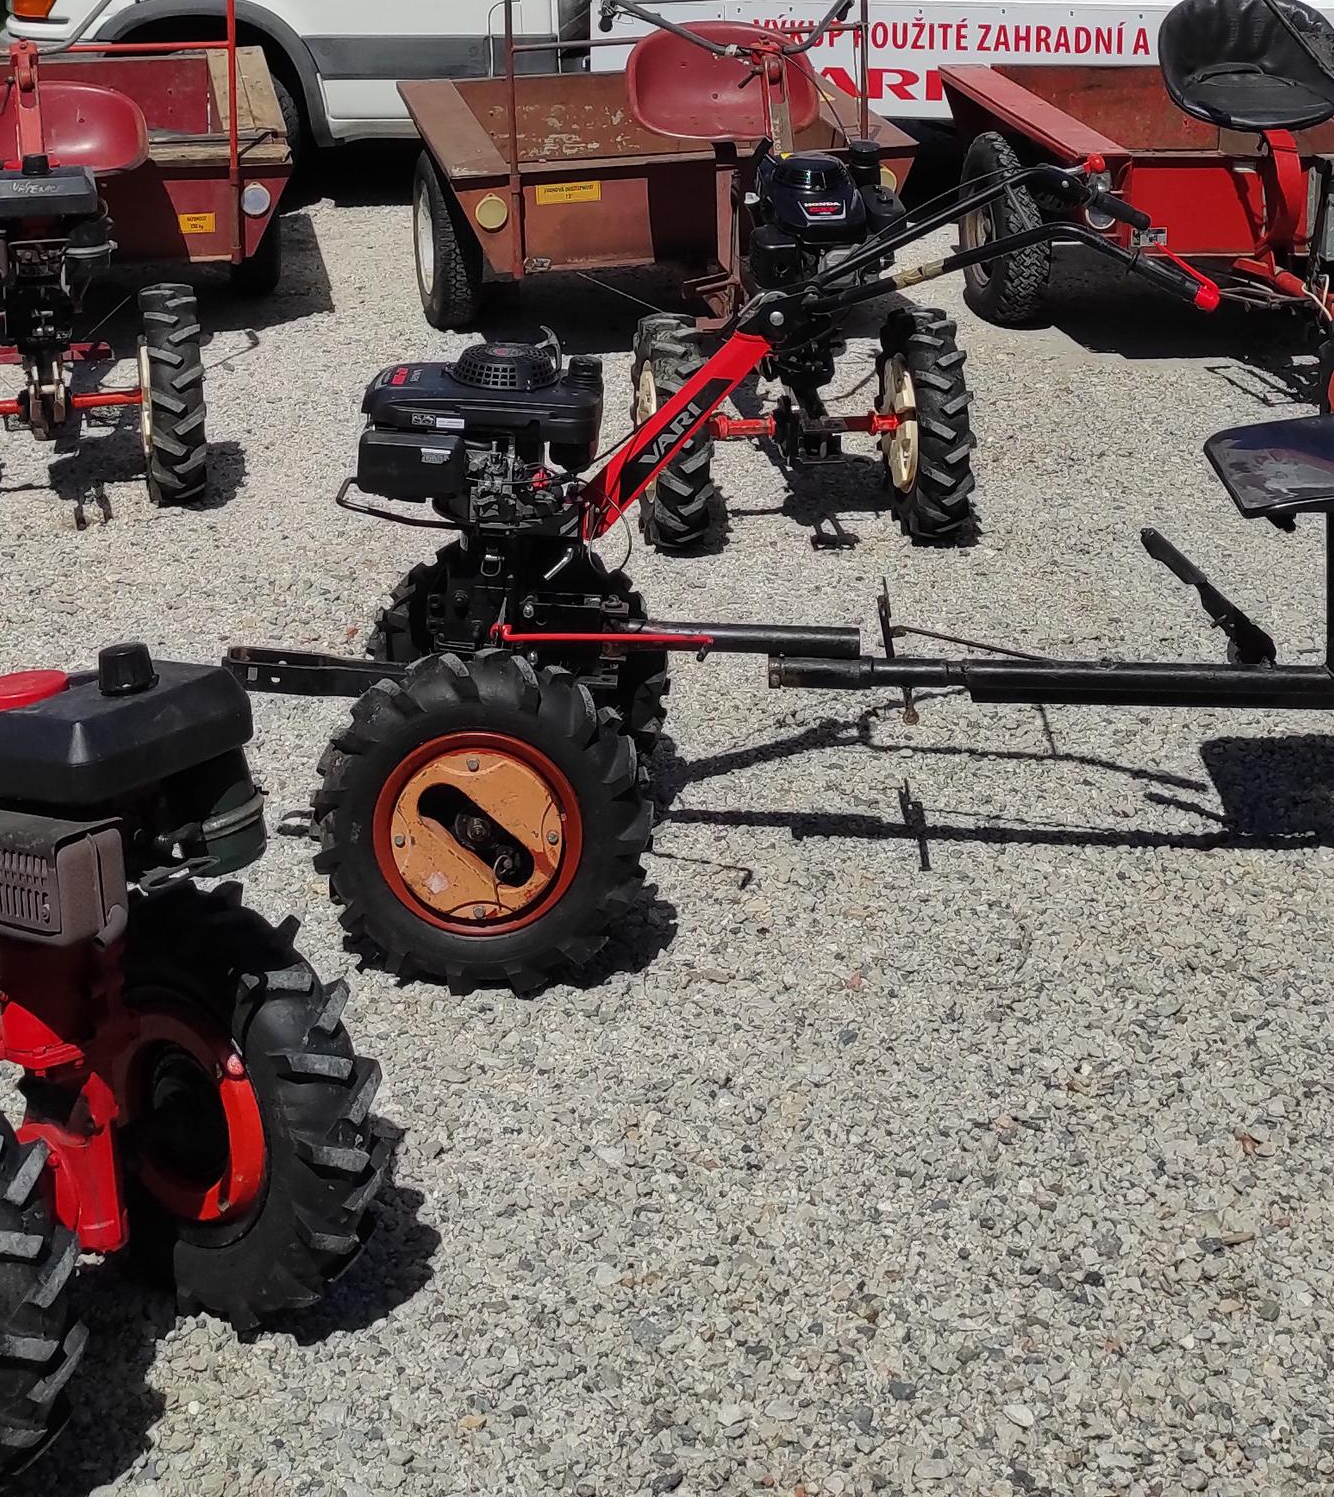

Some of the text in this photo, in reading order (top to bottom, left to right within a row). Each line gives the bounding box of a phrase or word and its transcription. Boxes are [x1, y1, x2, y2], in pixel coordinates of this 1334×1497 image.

[976, 23, 1124, 55] ZAHRADNÍ
[1132, 27, 1150, 56] A
[821, 66, 943, 102] ARI
[637, 401, 704, 464] VARI
